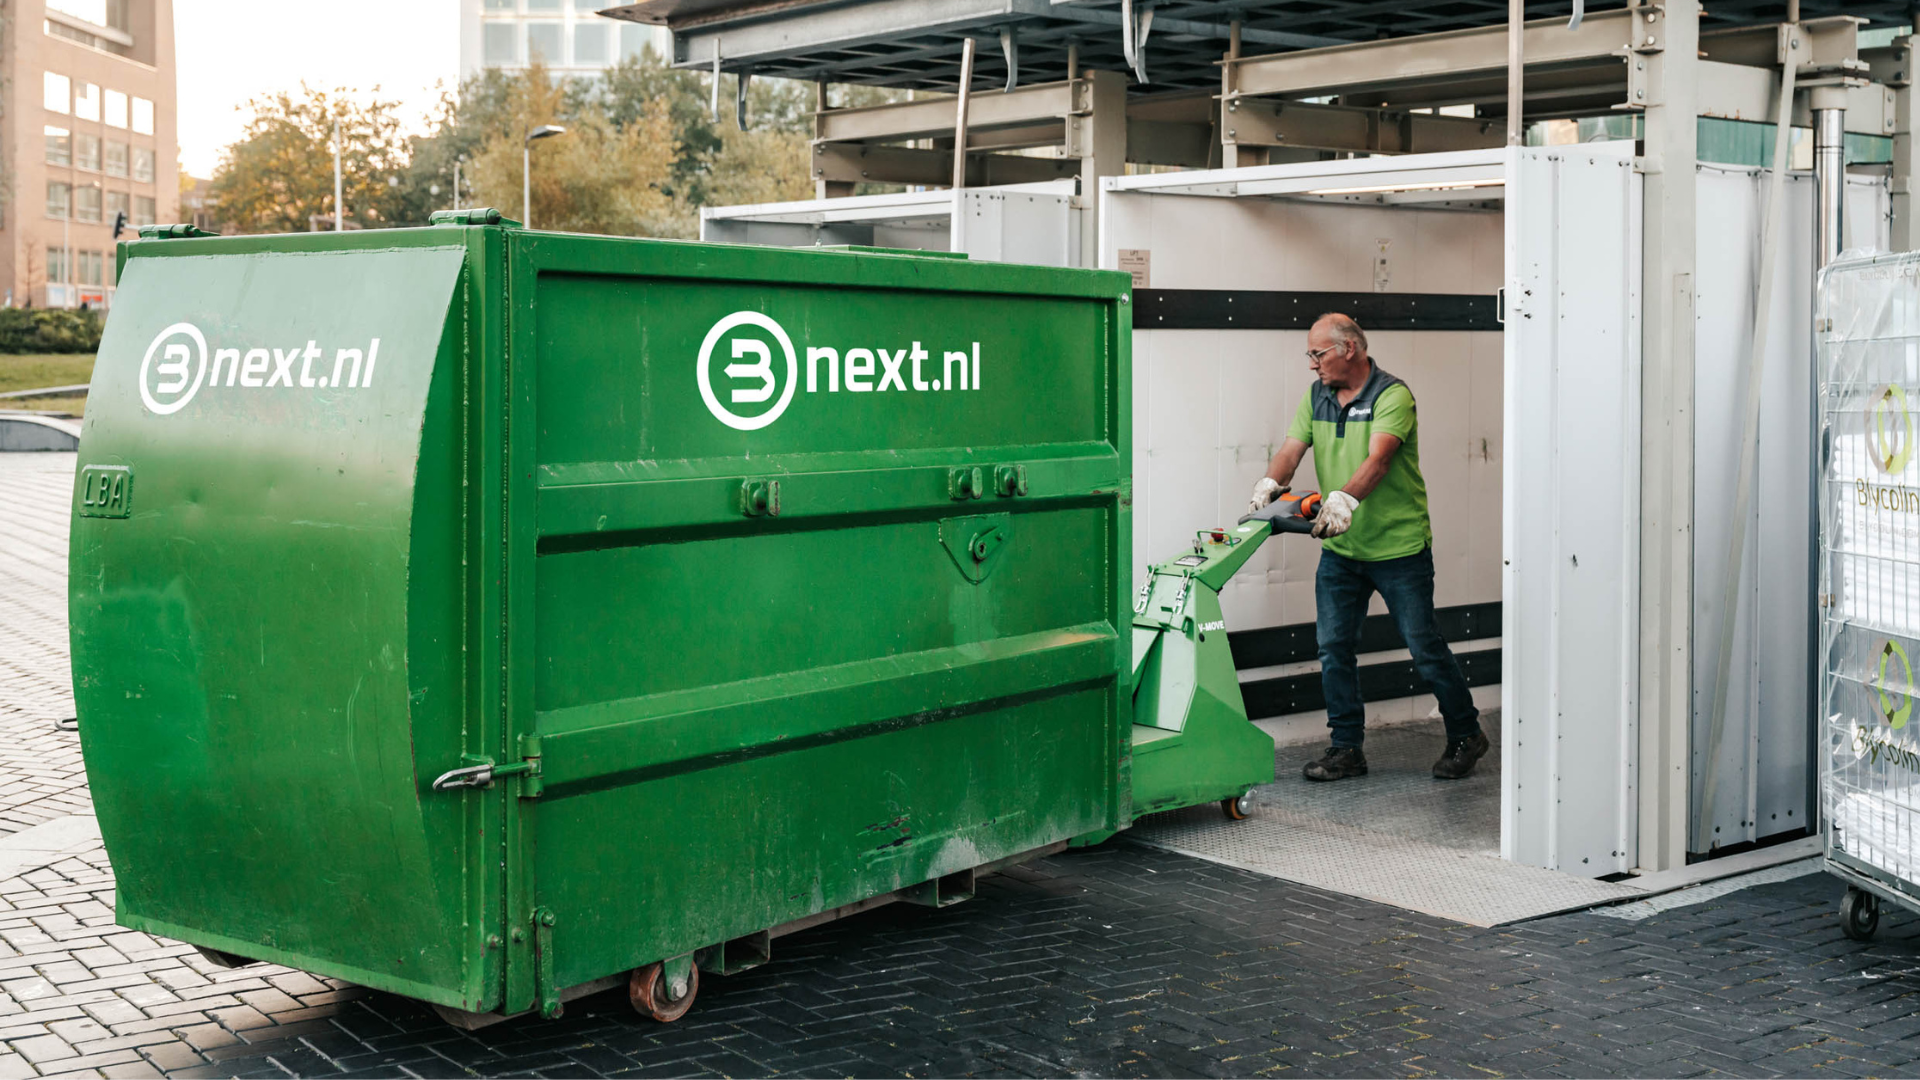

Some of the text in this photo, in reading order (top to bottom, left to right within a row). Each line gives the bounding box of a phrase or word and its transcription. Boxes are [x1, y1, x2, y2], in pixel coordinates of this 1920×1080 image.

[84, 473, 124, 509] LBA
[1856, 477, 1920, 515] Blycolin
[1198, 620, 1225, 632] V-MOVE
